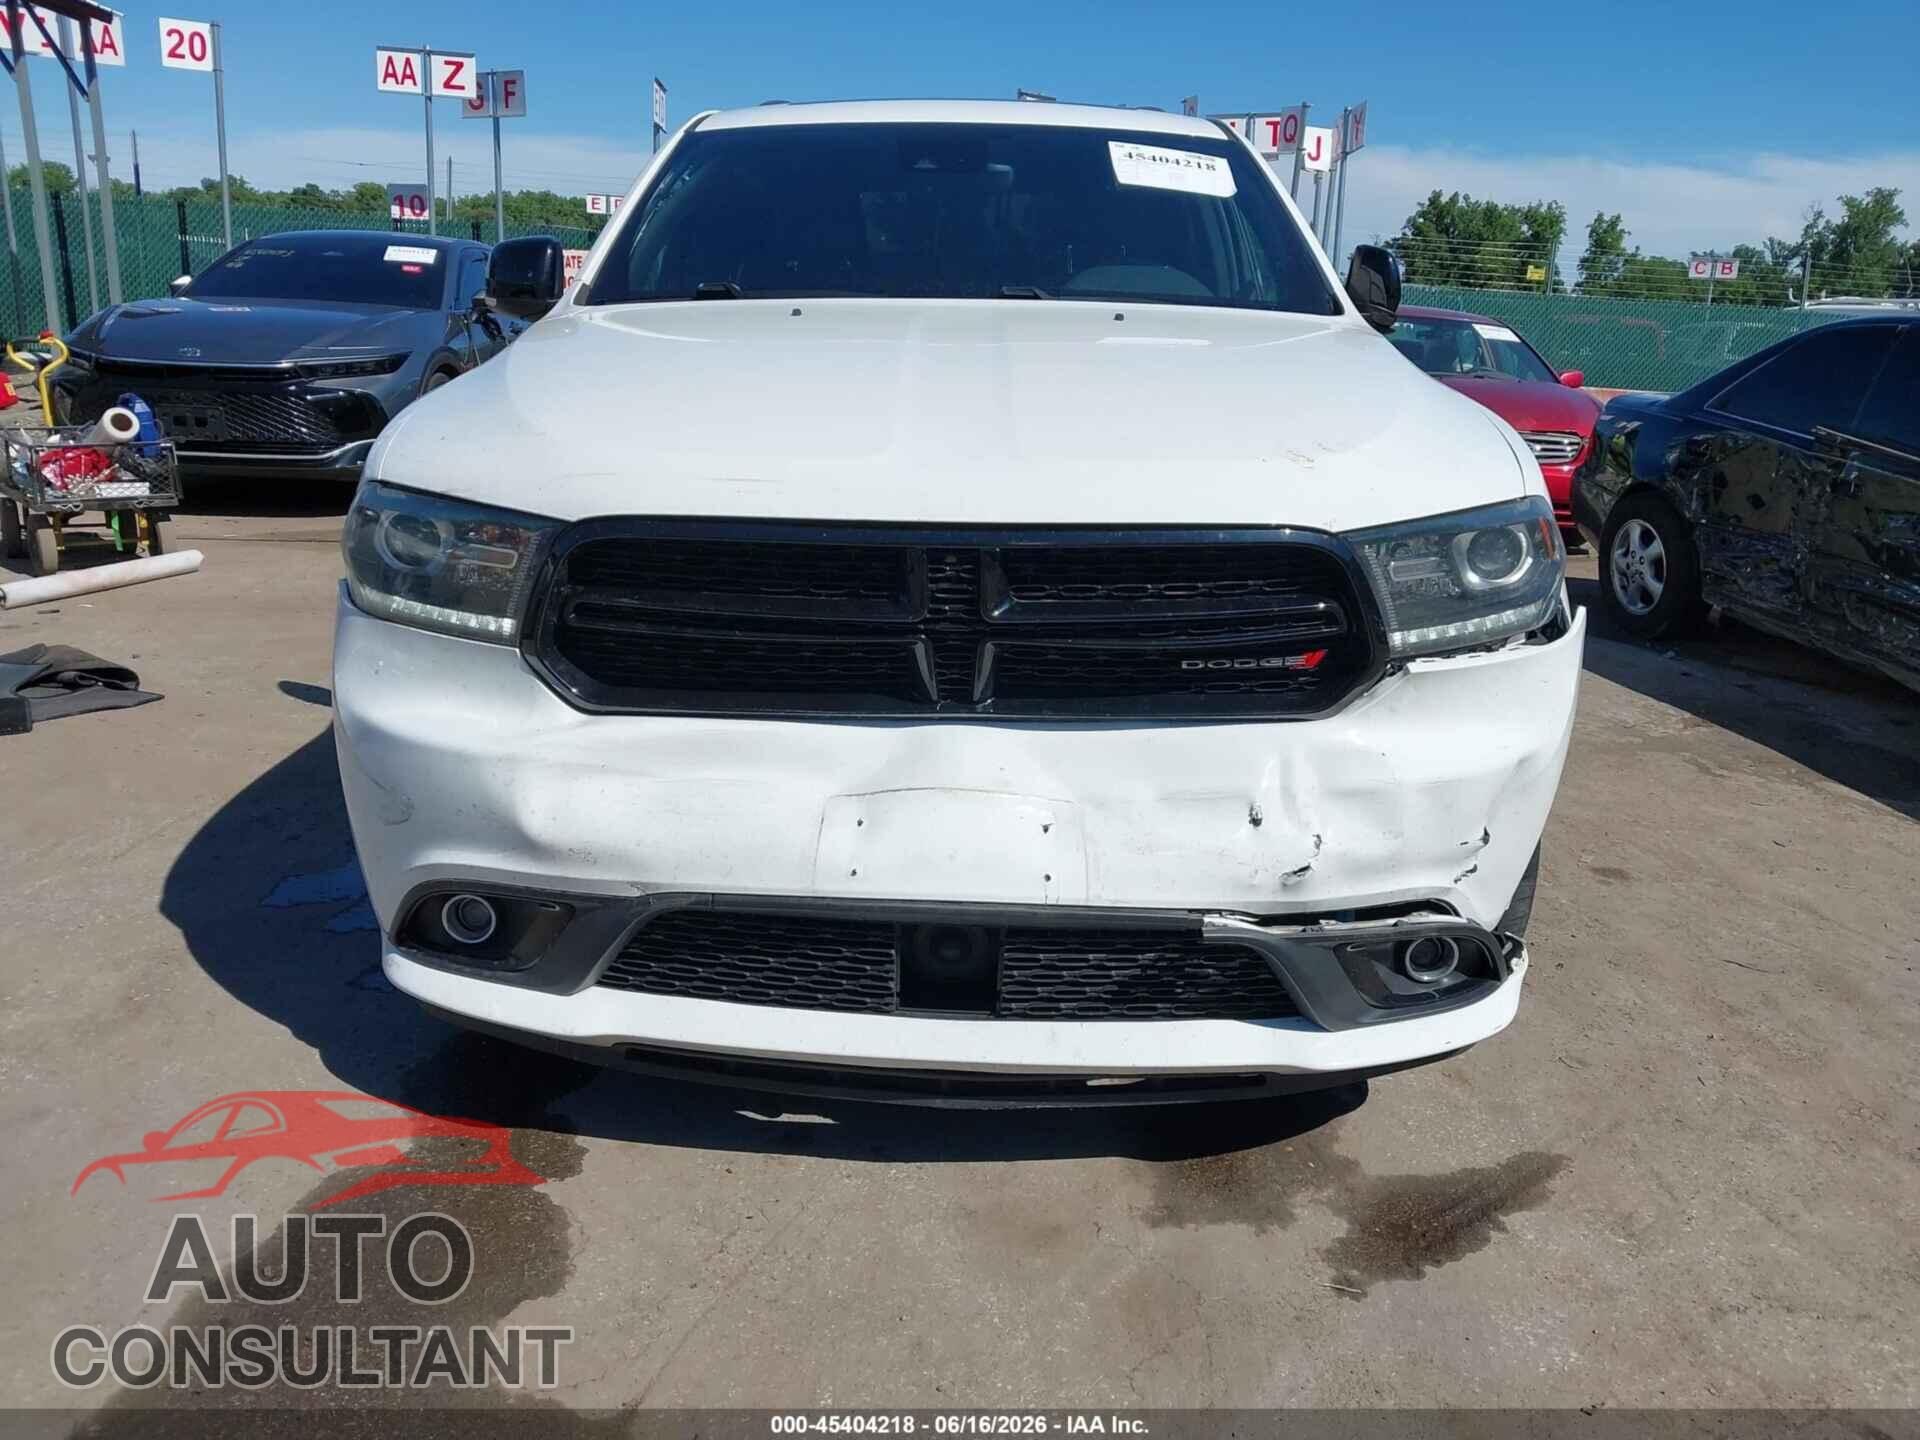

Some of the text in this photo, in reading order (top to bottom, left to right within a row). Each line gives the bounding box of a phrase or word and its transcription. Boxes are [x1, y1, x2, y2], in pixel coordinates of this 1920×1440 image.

[165, 27, 208, 63] 20
[382, 55, 418, 86] AA
[442, 59, 466, 91] Z
[503, 79, 517, 109] F
[1265, 120, 1281, 147] T
[1283, 114, 1298, 144] Q
[1353, 110, 1364, 144] Y
[1307, 135, 1322, 162] J
[393, 194, 426, 218] 10
[591, 197, 601, 210] E
[1695, 261, 1706, 275] C
[1721, 262, 1733, 275] B
[1181, 655, 1307, 669] DODGE
